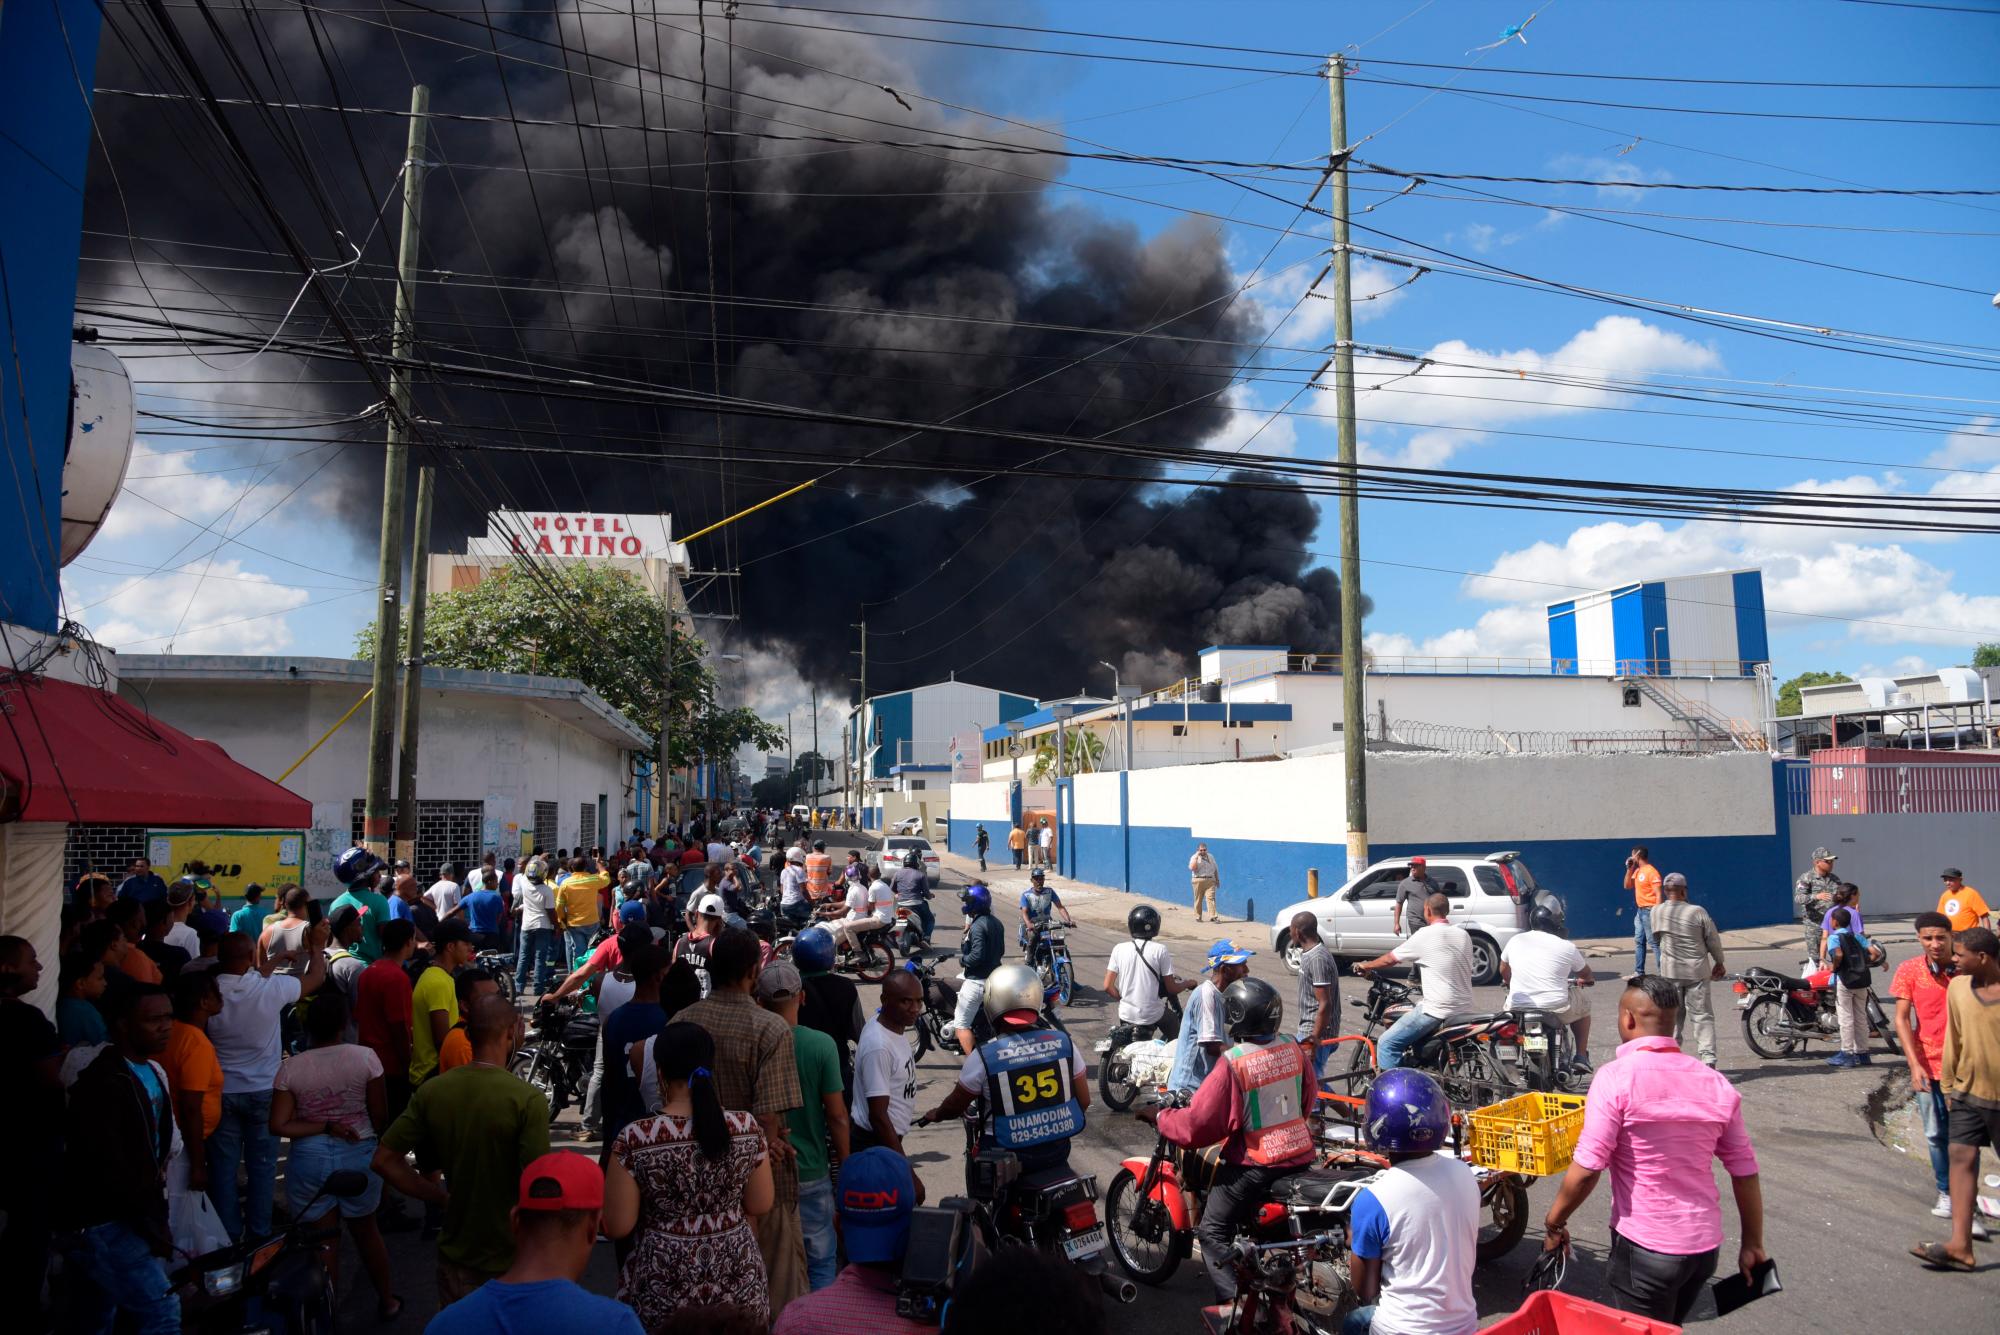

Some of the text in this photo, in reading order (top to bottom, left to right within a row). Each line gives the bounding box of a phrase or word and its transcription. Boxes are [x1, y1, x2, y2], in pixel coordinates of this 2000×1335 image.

[533, 516, 624, 533] HOTEL
[511, 533, 642, 556] LATINO
[1832, 766, 1843, 780] 45
[997, 1039, 1063, 1060] DAYUN
[1016, 1068, 1059, 1103] 35
[1009, 1106, 1072, 1131] UNAMODINA
[1011, 1119, 1074, 1143] 829-543-0380
[844, 1188, 898, 1209] CDN
